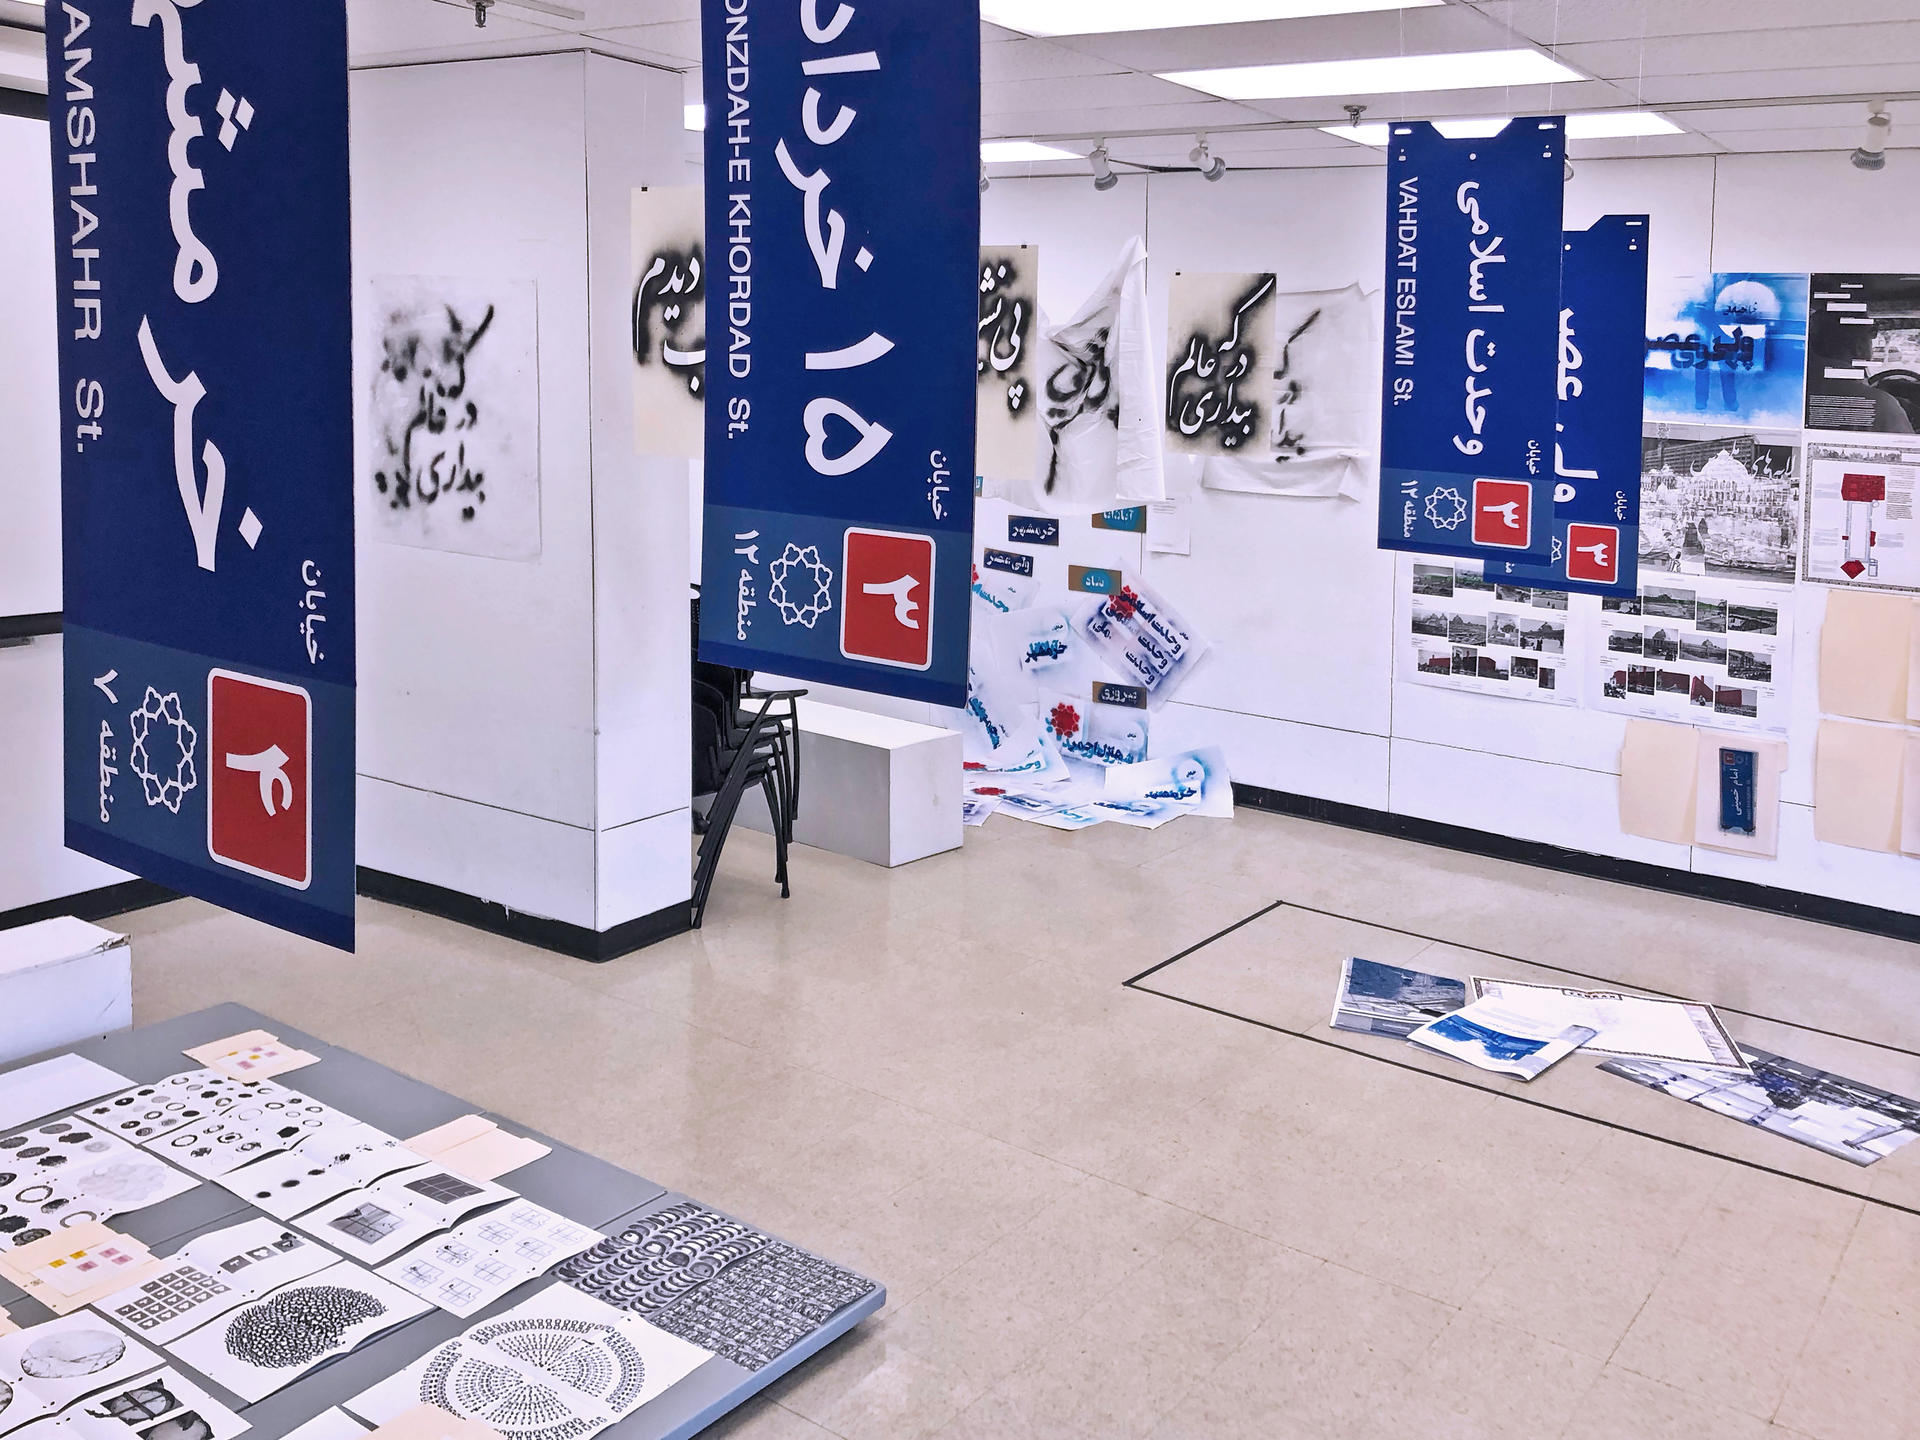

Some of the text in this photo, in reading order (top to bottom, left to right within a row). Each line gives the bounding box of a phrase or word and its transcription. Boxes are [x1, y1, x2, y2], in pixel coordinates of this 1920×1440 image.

[774, 0, 881, 290] خرداد
[635, 256, 701, 352] دیدم
[727, 194, 752, 380] KHORDAD
[1218, 277, 1275, 352] که
[1393, 176, 1420, 407] VAHDAT ESLAMI St.
[1452, 180, 1506, 457] وحدت اسلامی
[1169, 336, 1249, 417] در عالم
[76, 377, 104, 454] St.
[727, 397, 752, 440] St.
[1179, 382, 1253, 447] بیداری
[926, 449, 951, 521] خیابان
[1526, 438, 1541, 476] خیابان
[1011, 522, 1057, 541] خرمشهر
[1403, 500, 1413, 539] منطقه
[1482, 500, 1520, 530] ۳
[1614, 489, 1628, 521] خیابان
[733, 528, 760, 641] منطقه ۱۲
[1575, 540, 1609, 567] ۳
[299, 559, 327, 665] خیابان
[861, 573, 921, 630] ۳
[99, 719, 120, 824] منطقه
[225, 743, 292, 818] ۴
[1729, 768, 1743, 786] امام
[1730, 788, 1743, 816] خمینی
